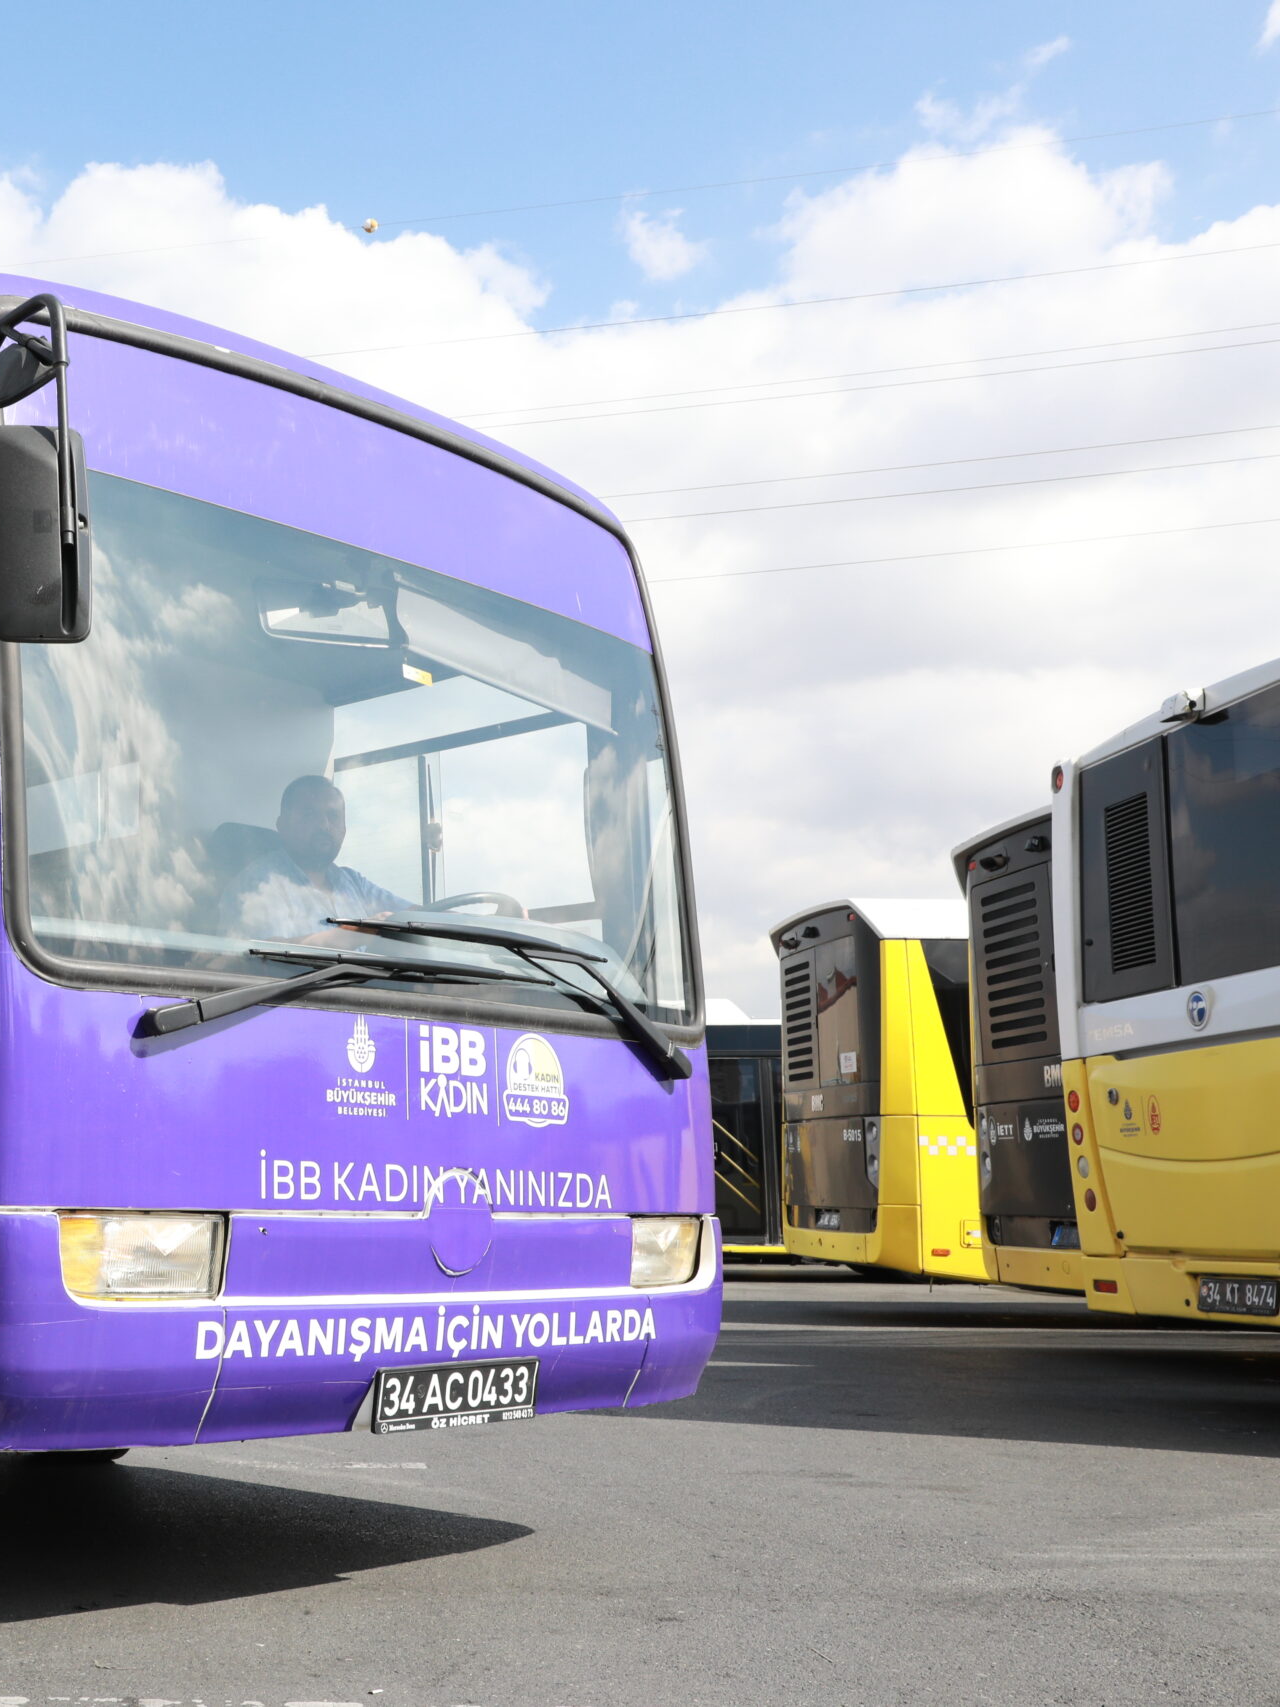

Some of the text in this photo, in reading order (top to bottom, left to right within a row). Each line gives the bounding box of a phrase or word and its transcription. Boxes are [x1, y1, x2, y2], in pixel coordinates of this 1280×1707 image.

[337, 1076, 386, 1090] İSTANBUL
[535, 1072, 559, 1084] KADIN
[1044, 1064, 1062, 1087] BM
[326, 1087, 396, 1106] BÜYÜKŞEHİR
[420, 1074, 488, 1118] KADIN
[513, 1082, 560, 1094] DESTEK HATTI
[337, 1105, 386, 1117] BELEDİYESİ
[508, 1097, 565, 1117] 444 80 86
[260, 1149, 612, 1209] İBB KADIN YANINIZDA
[1207, 1283, 1273, 1306] 34 KT 8474
[195, 1305, 657, 1362] DAYANIŞMA İÇİN YOLLARDA
[384, 1376, 415, 1417] 34
[431, 1417, 447, 1429] ÖZ
[449, 1414, 490, 1427] HİCRET
